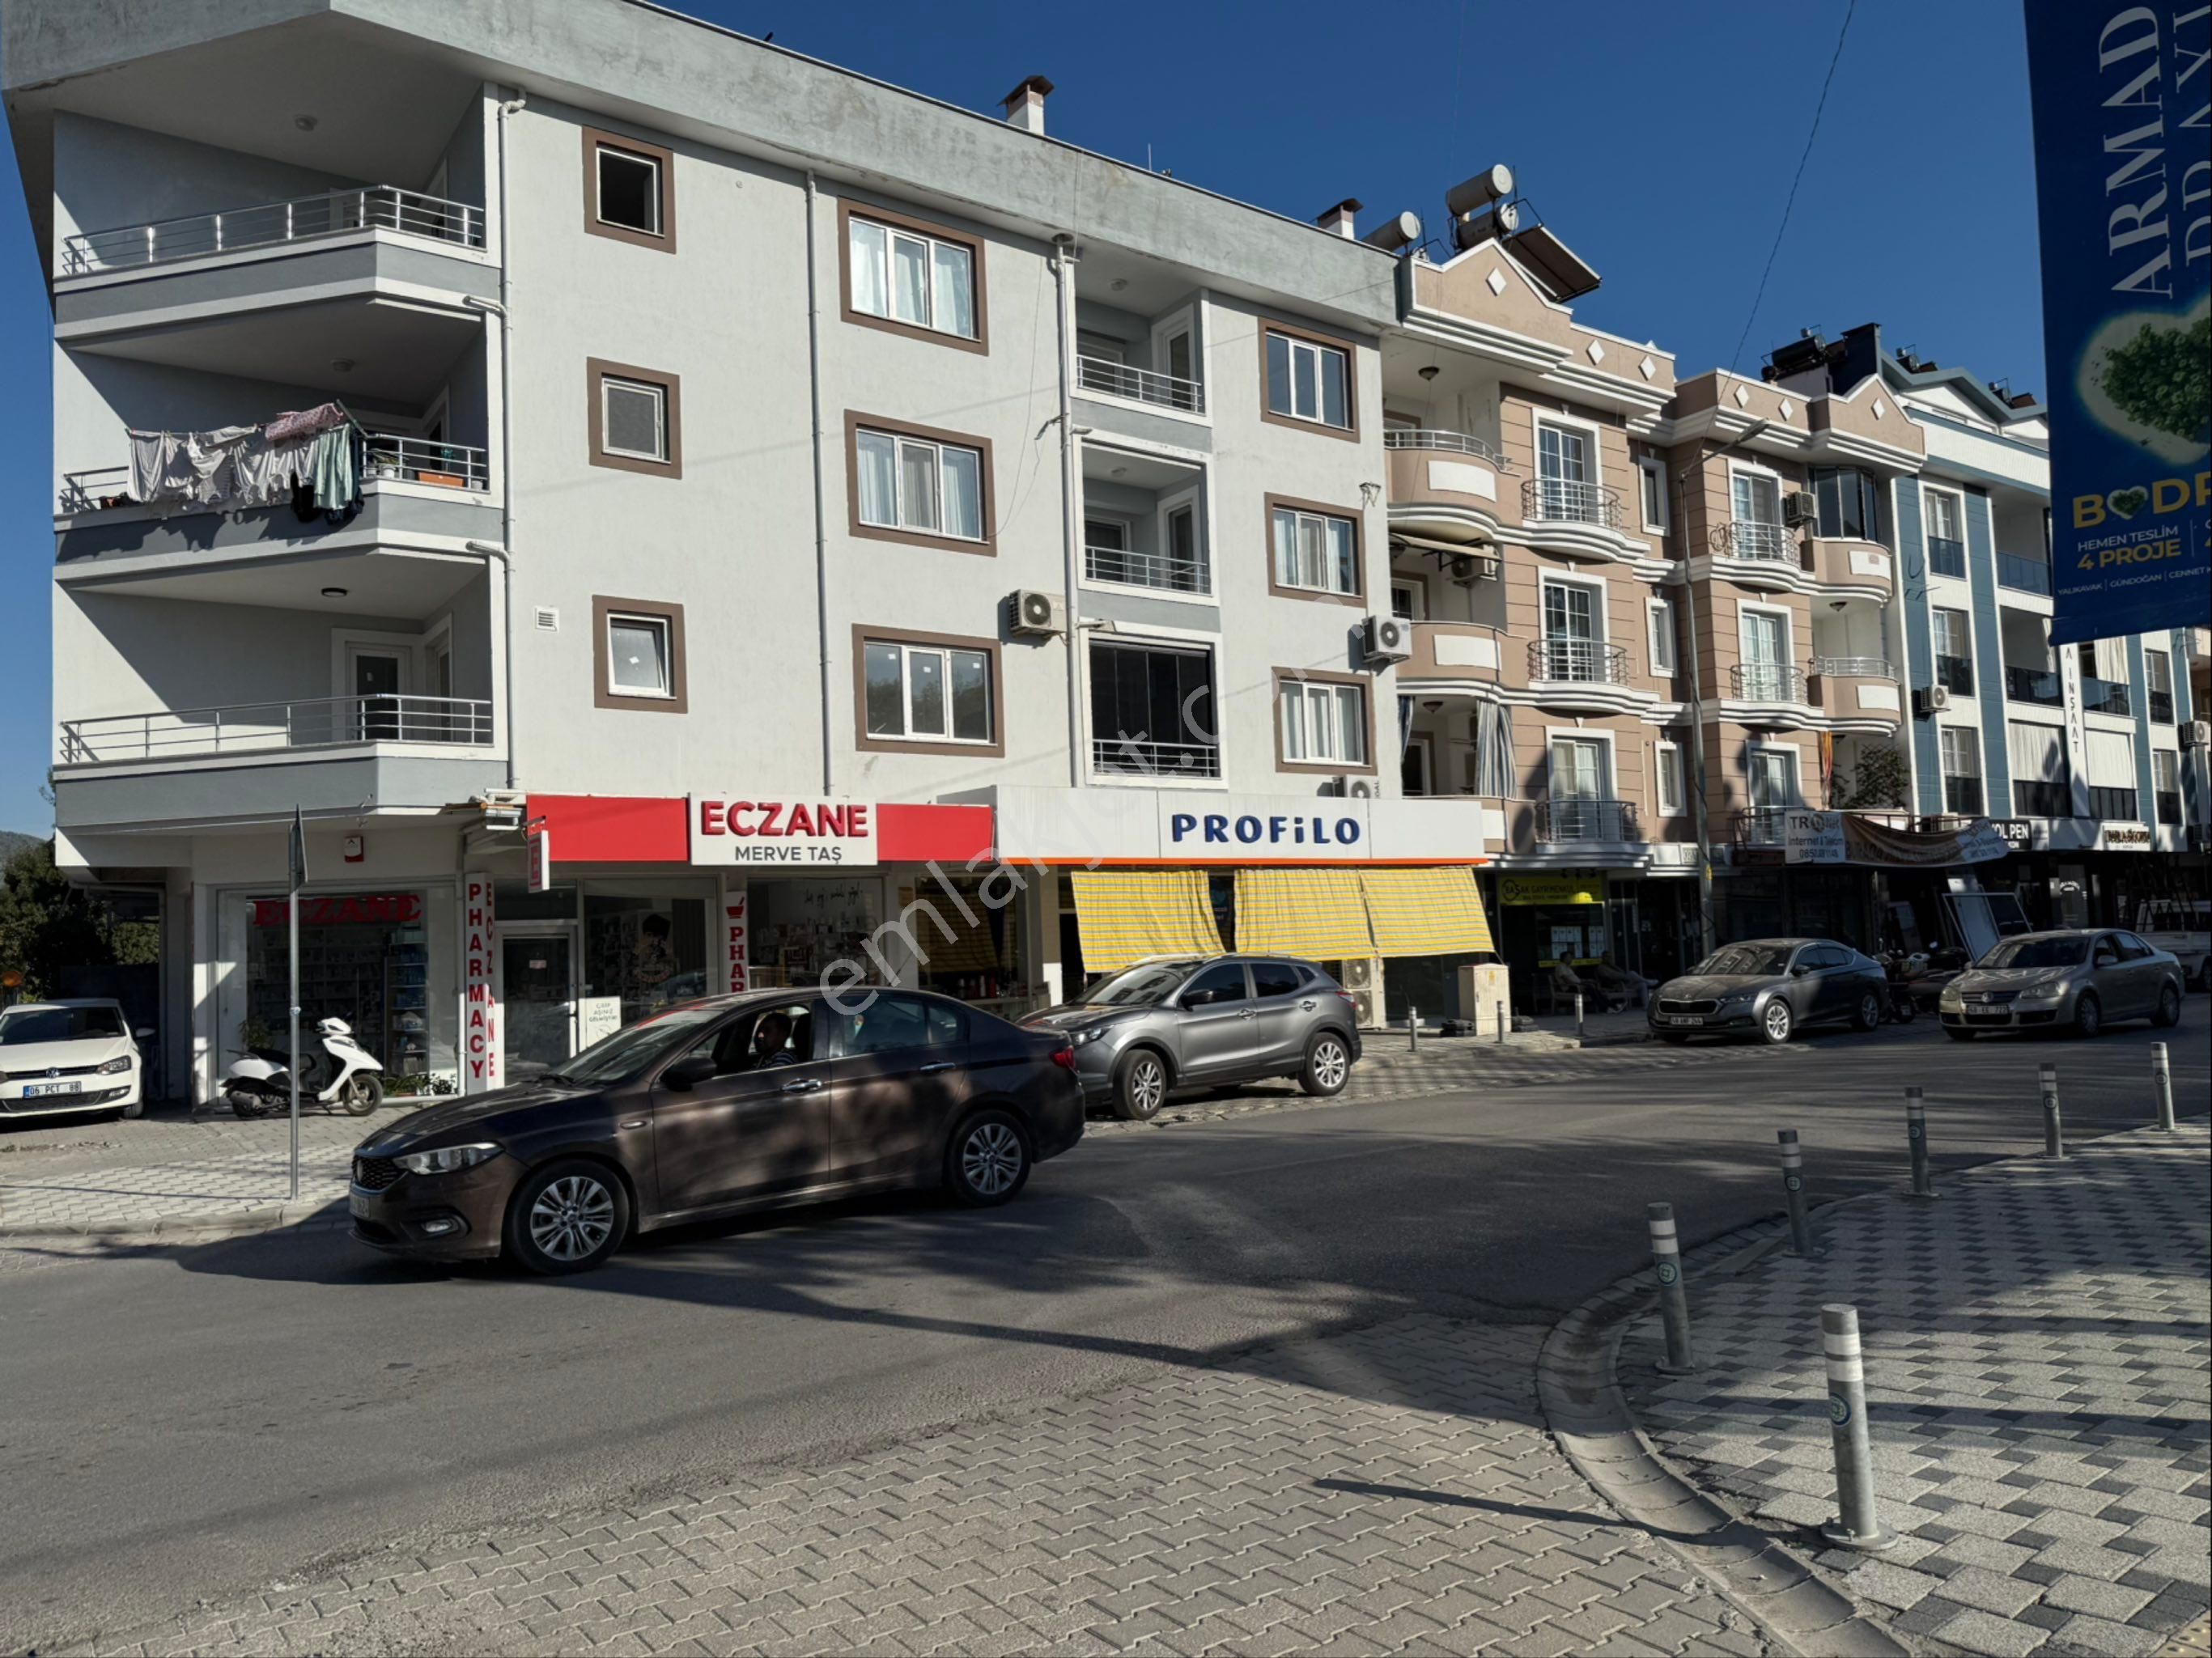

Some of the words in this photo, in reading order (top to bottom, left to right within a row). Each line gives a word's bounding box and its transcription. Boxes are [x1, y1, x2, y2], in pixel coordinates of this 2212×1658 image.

[2077, 553, 2095, 570] 4
[2099, 538, 2182, 568] PROJE
[2078, 534, 2127, 552] HEMEN
[2129, 524, 2179, 543] TESLİM
[2168, 566, 2205, 579] CENNET
[701, 801, 868, 837] ECZANE
[1991, 824, 2008, 839] OL
[2010, 824, 2029, 839] PEN
[735, 846, 801, 861] MERVE
[808, 846, 842, 864] TAŞ
[253, 893, 422, 927] ECZANE
[469, 884, 485, 1079] PHARMACY
[486, 883, 495, 1077] ECZANE
